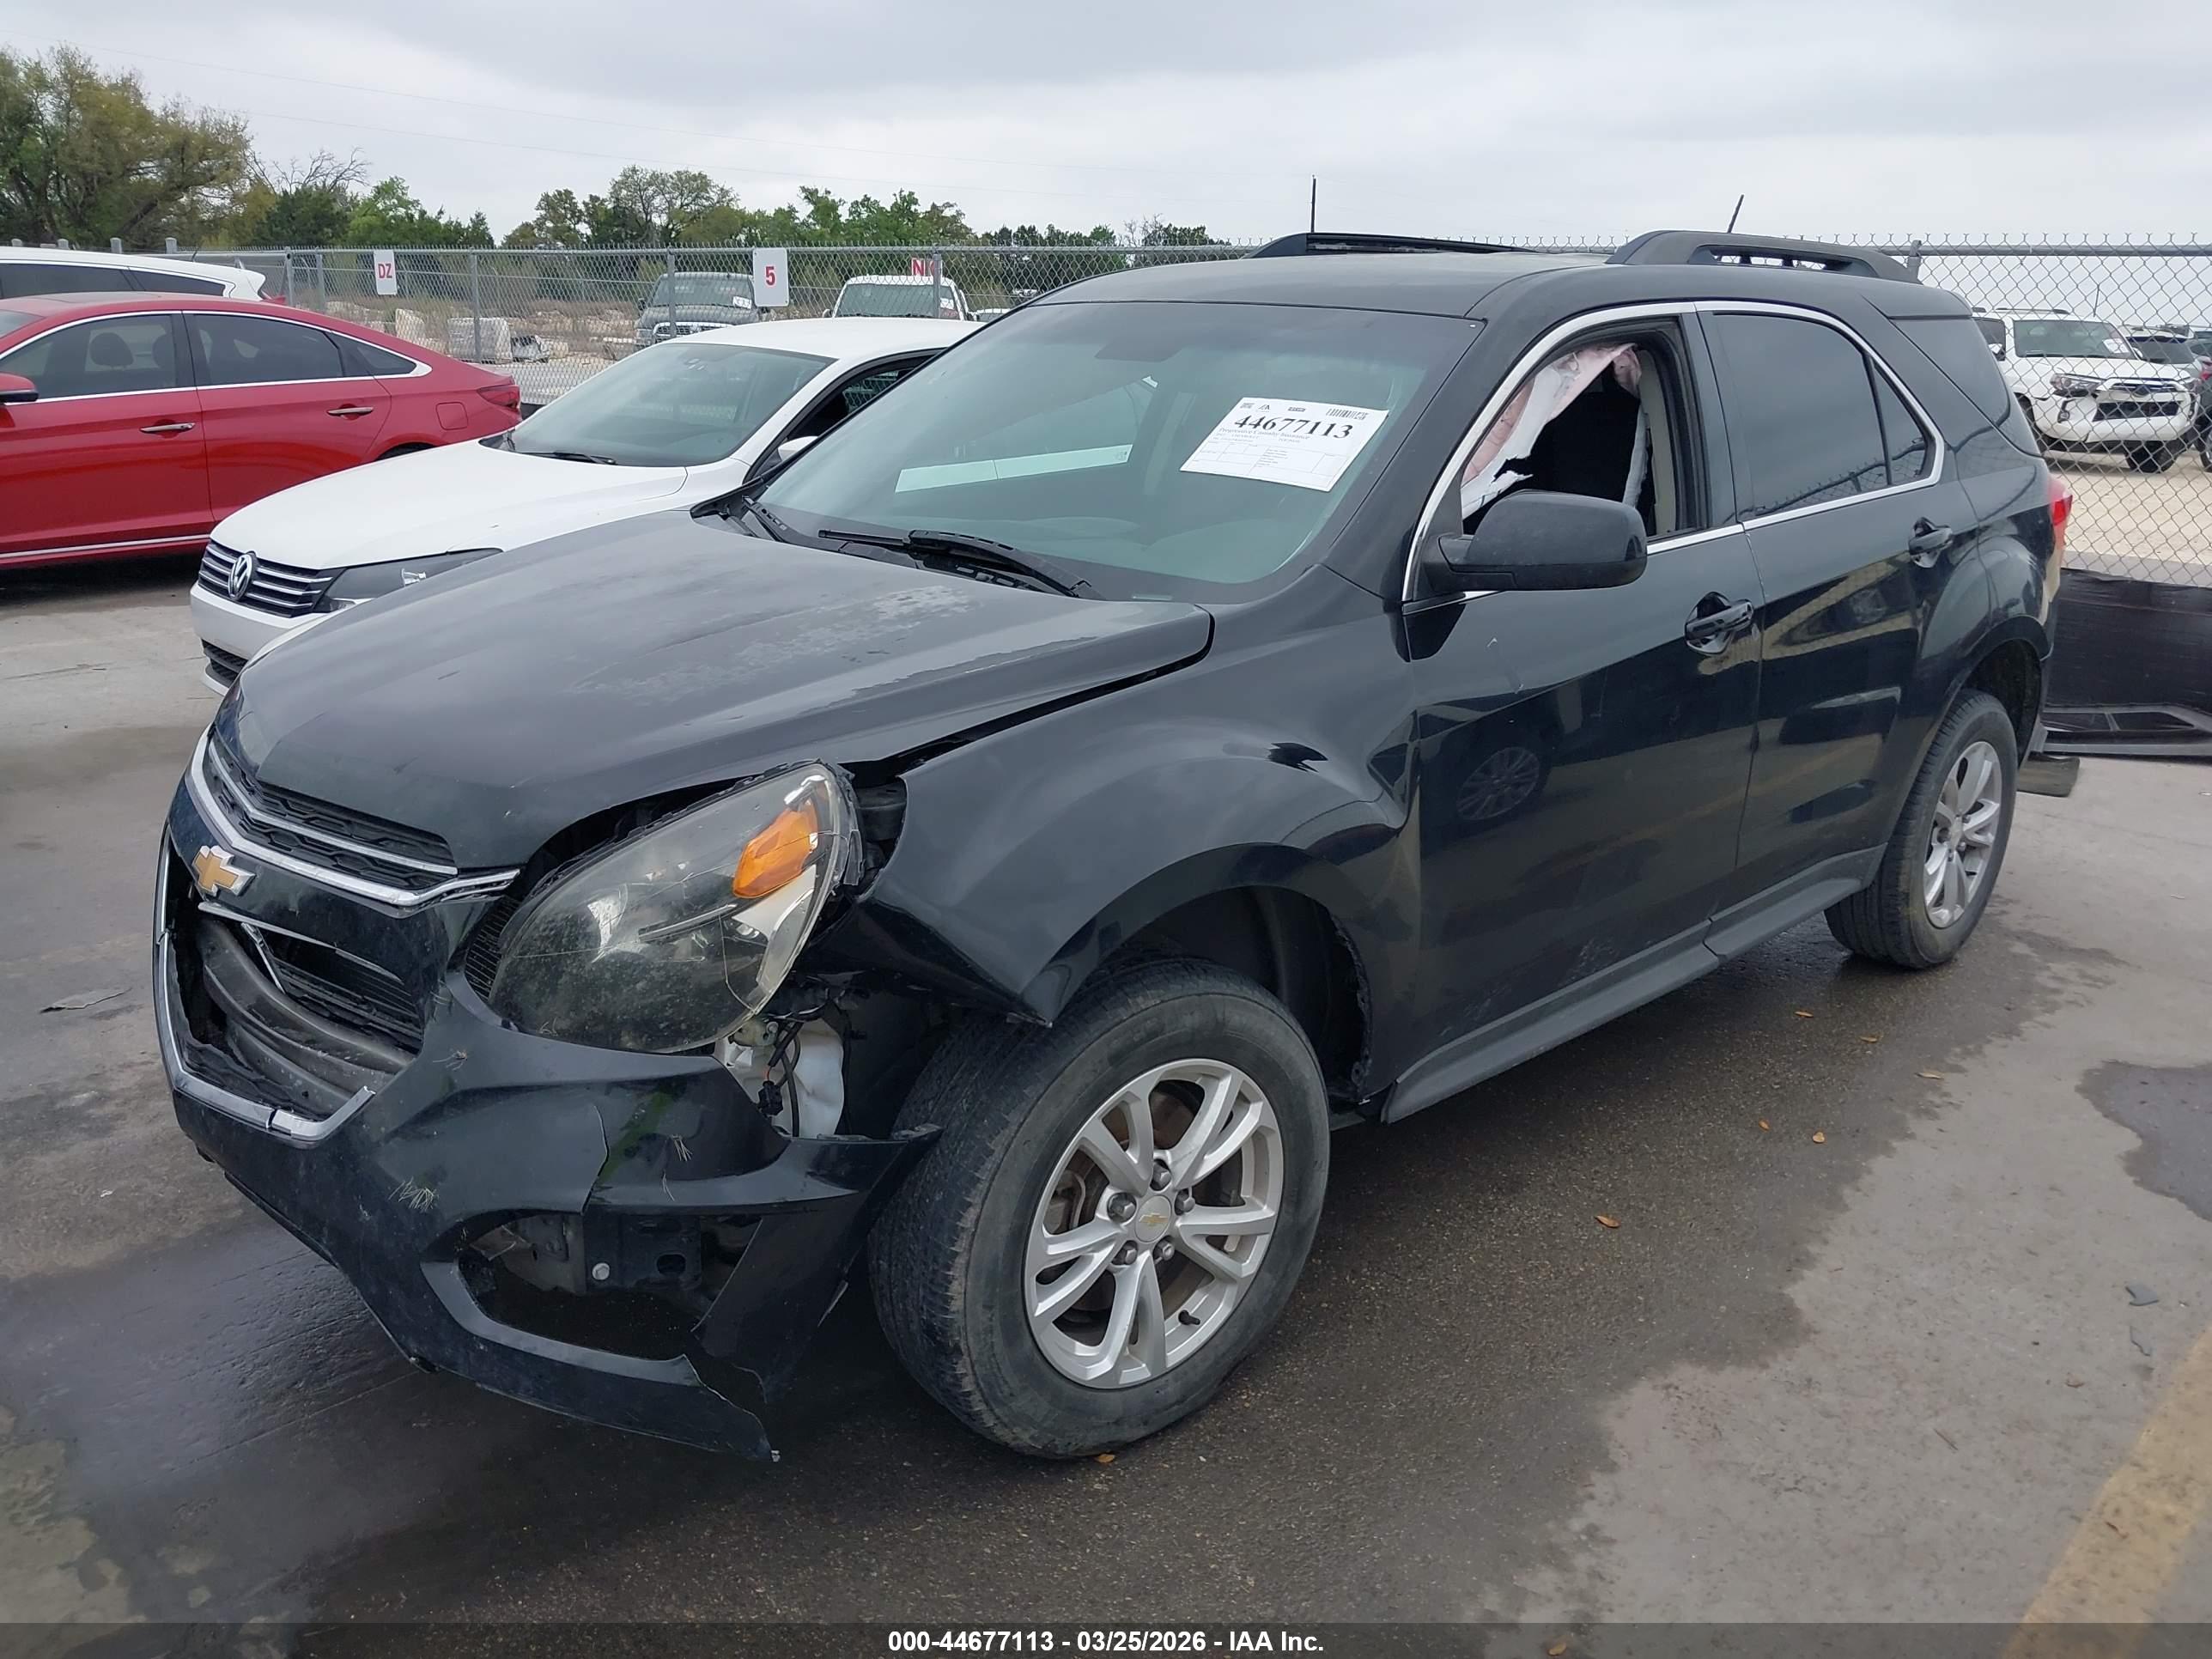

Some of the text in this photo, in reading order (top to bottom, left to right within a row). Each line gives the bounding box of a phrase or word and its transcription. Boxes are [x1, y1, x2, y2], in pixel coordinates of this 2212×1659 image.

[378, 263, 392, 279] DZ
[765, 265, 775, 286] 5
[1234, 415, 1353, 439] 44677113
